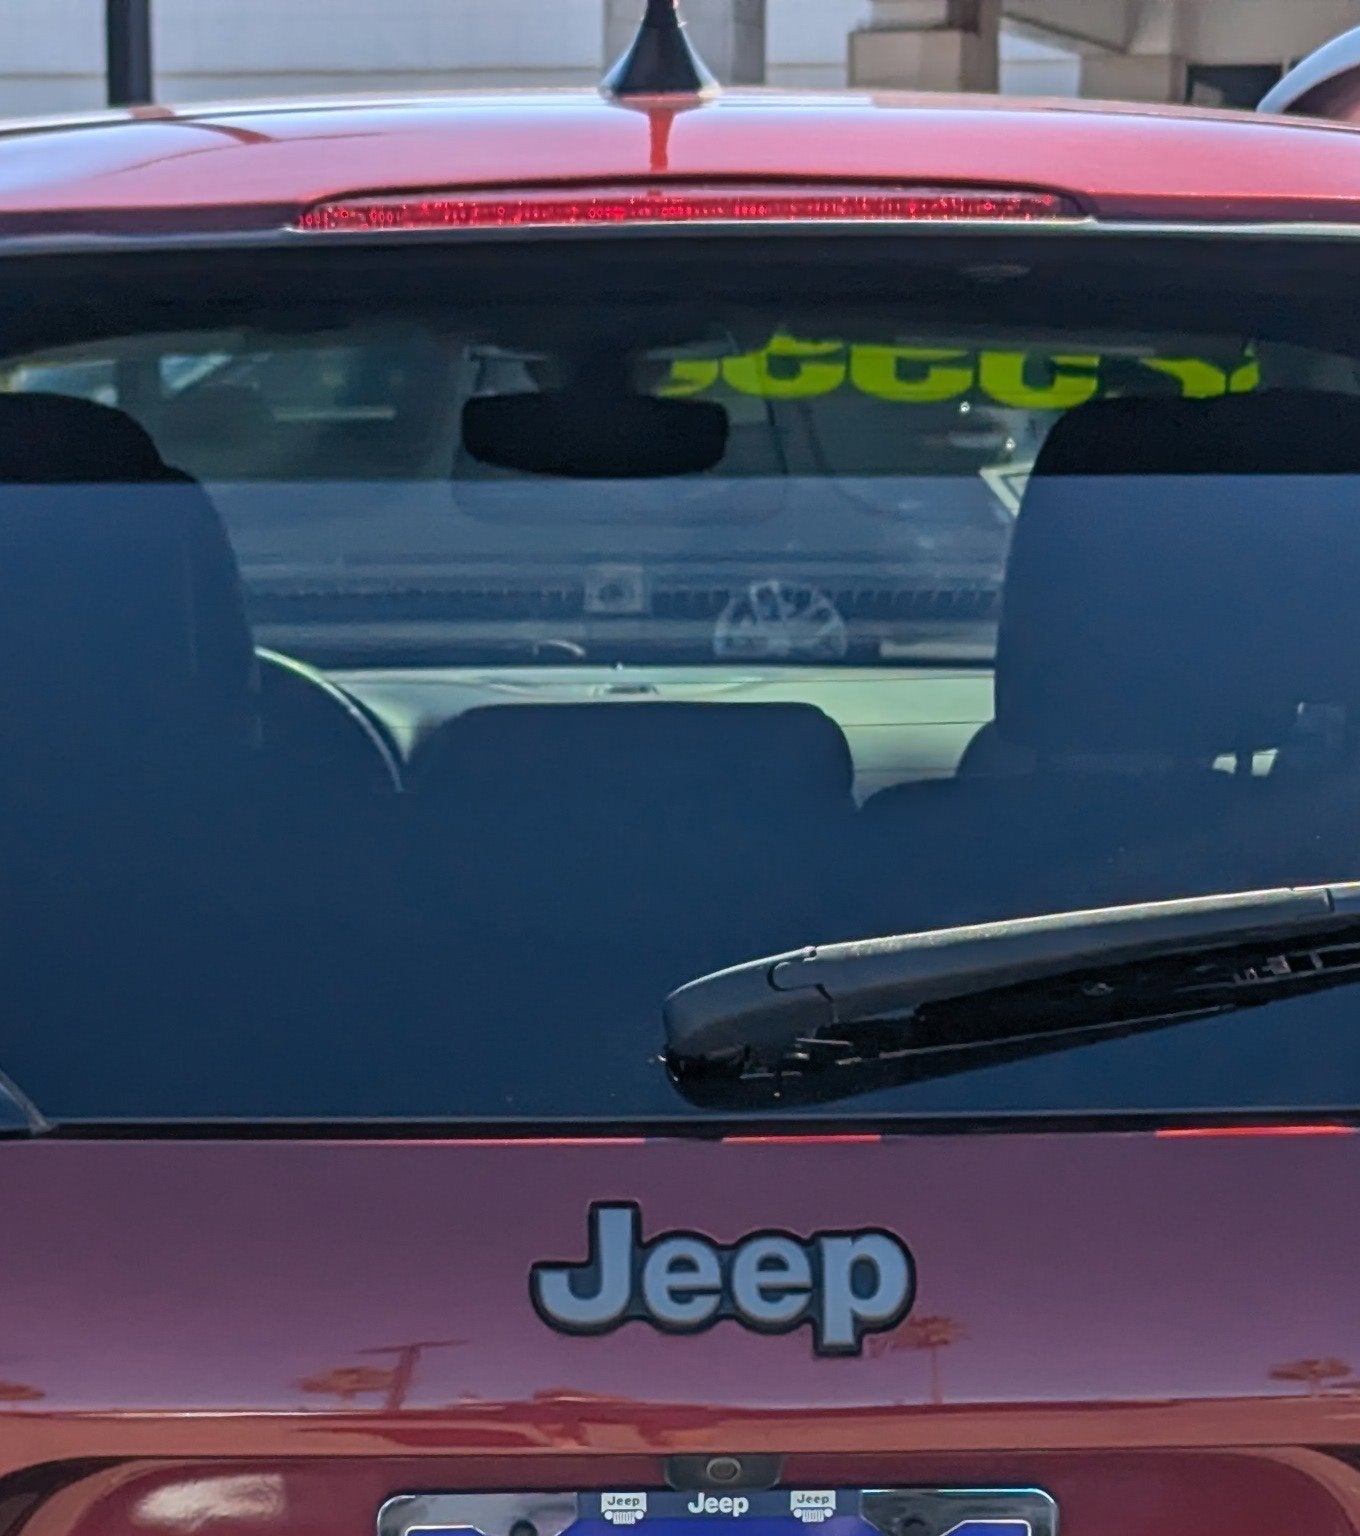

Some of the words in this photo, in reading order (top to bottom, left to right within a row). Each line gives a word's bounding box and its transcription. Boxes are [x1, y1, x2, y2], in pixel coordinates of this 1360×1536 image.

[530, 1201, 915, 1356] Jeep
[607, 1495, 640, 1508] Jeep
[687, 1492, 749, 1517] Jeep
[797, 1492, 830, 1505] Jeep
